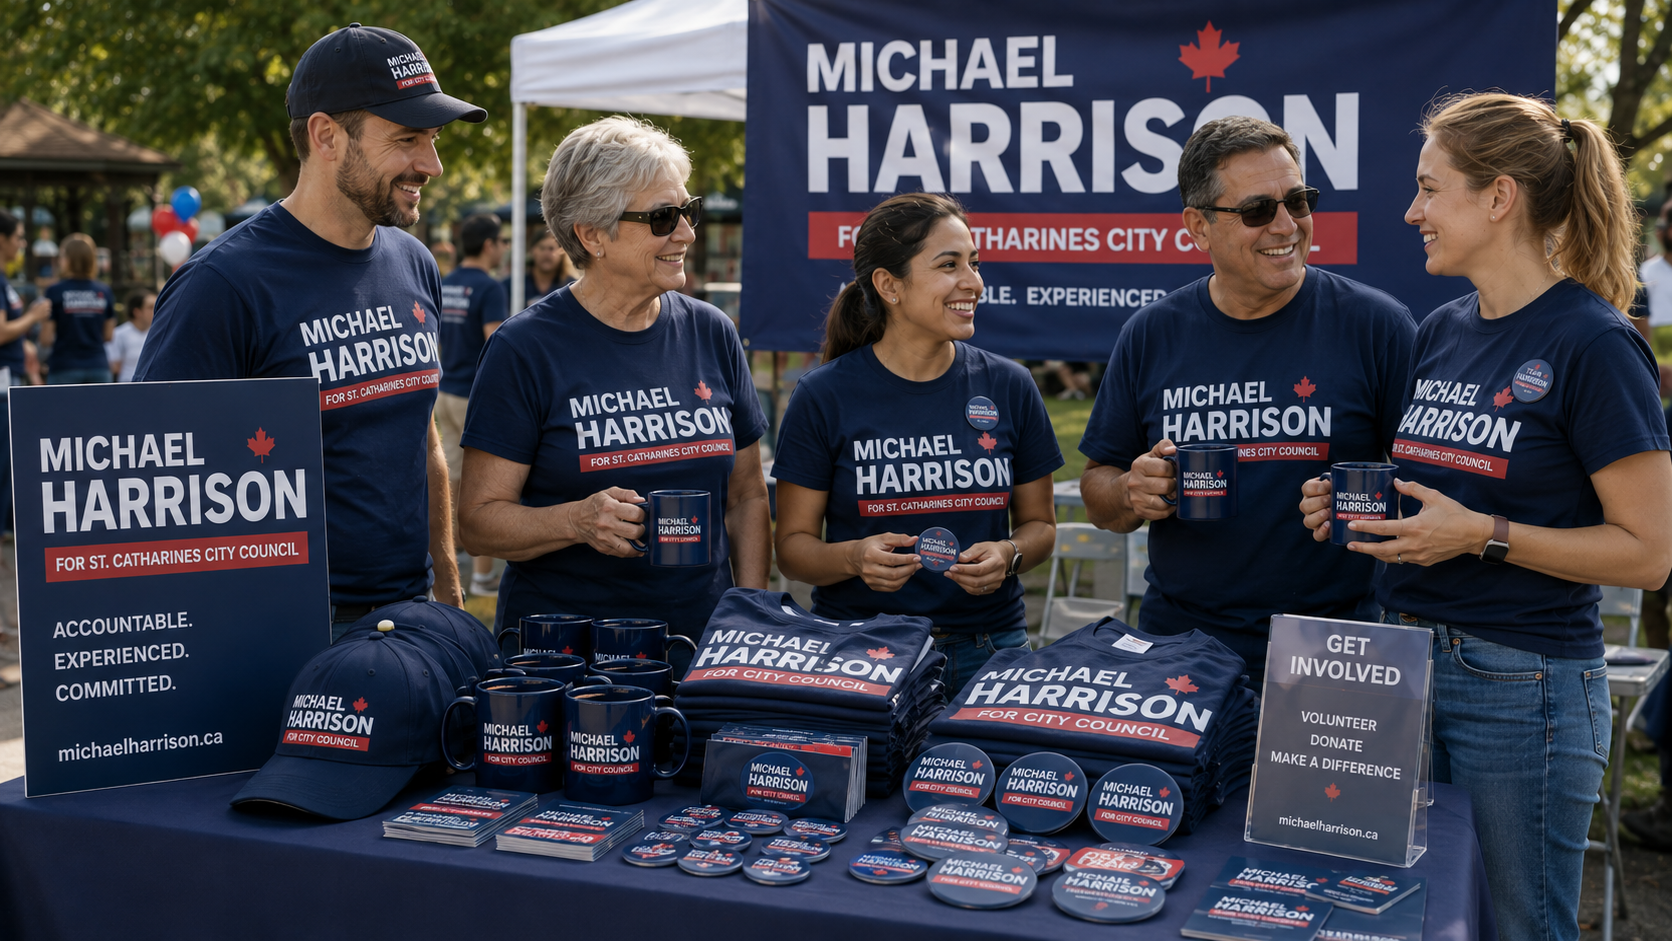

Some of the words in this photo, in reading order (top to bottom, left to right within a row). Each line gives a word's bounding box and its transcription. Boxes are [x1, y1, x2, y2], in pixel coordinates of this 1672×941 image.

[806, 35, 1074, 93] MICHAEL
[807, 92, 1360, 194] HARRISN
[970, 227, 1100, 252] THARINES
[1107, 228, 1168, 252] CITY
[299, 305, 402, 347] MICHAEL
[308, 332, 439, 384] HARRISON
[326, 392, 345, 405] FOR
[347, 389, 359, 400] ST.
[360, 379, 405, 398] CATHARINES
[405, 376, 422, 388] CITY
[1163, 381, 1272, 410] MICHAEL
[1413, 379, 1480, 406] MICHAEL
[569, 386, 680, 419] MICHAEL
[574, 406, 731, 450] HARRISON
[1163, 405, 1331, 442] HARRISON
[40, 432, 205, 473] MICHAEL
[590, 456, 610, 467] FOR
[612, 454, 626, 465] ST.
[627, 448, 680, 463] CATHARINES
[681, 445, 699, 456] CITY
[853, 434, 962, 461] MICHAEL
[1258, 447, 1277, 457] CITY
[1279, 446, 1319, 456] COUNCIL
[1441, 452, 1455, 463] CITY
[1455, 454, 1493, 472] COUNCIL
[855, 457, 1011, 495] HARRISON
[1183, 479, 1227, 489] HARRISON
[41, 469, 307, 534] HARRISON
[867, 503, 885, 513] FOR
[886, 502, 899, 512] ST.
[901, 499, 953, 511] CATHARINES
[954, 498, 973, 507] CITY
[1336, 501, 1386, 512] HARRISON
[658, 525, 701, 535] HARRISON
[56, 557, 85, 571] FOR
[89, 554, 110, 569] ST.
[112, 548, 201, 568] CATHARINES
[204, 545, 236, 561] CITY
[239, 542, 299, 560] COUNCIL
[53, 611, 193, 639] ACCOUNTABLE.
[708, 630, 832, 655] MICHAEL
[1326, 634, 1371, 656] GET
[54, 642, 190, 670] EXPERIENCED.
[695, 646, 903, 684] HARRISON
[703, 668, 738, 678] FOR
[743, 669, 785, 682] CITY
[788, 675, 868, 692] COUNCIL
[980, 665, 1132, 689] MICHAEL
[1290, 655, 1401, 686] INVOLVED
[55, 674, 177, 702] COMMITTED.
[293, 694, 346, 711] MICHAEL
[964, 682, 1213, 733] HARRISON
[286, 710, 374, 735] HARRISON
[484, 722, 533, 737] MICHAEL
[976, 710, 1019, 720] FOR
[1024, 712, 1071, 727] CITY
[1075, 718, 1170, 741] COUNCIL
[1301, 710, 1377, 731] VOLUNTEER
[58, 730, 223, 762] michaelharrison.ca
[298, 733, 316, 743] CITY
[316, 735, 359, 748] COUNCIL
[484, 735, 552, 753] HARRISON
[570, 731, 618, 746] MICHAEL
[1310, 733, 1363, 753] DONATE
[501, 756, 516, 764] CITY
[570, 745, 639, 762] HARRISON
[920, 756, 966, 769] MICHAEL
[587, 765, 601, 773] CITY
[750, 762, 792, 776] MICHAEL
[914, 766, 985, 785] HARRISON
[1010, 767, 1059, 781] MICHAEL
[1270, 750, 1307, 767] MAKE
[1309, 756, 1319, 768] A
[1321, 757, 1401, 780] DIFFERENCE
[748, 773, 808, 792] HARRISON
[1006, 778, 1078, 798] HARRISON
[1102, 781, 1153, 797] MICHAEL
[1022, 797, 1037, 805] CITY
[1098, 792, 1174, 816] HARRISON
[1101, 811, 1115, 820] FOR
[1115, 814, 1132, 823] CITY
[1278, 815, 1378, 841] michaelharrison.ca
[911, 829, 1002, 850] HARRISON
[938, 865, 1028, 886] HARRISON
[945, 858, 1004, 872] MICHAEL
[1243, 867, 1308, 882] MICHAEL
[1064, 875, 1157, 897] HARRISON
[1236, 872, 1319, 889] HARRIS
[1214, 900, 1315, 921] HARRISON
[1221, 896, 1287, 911] MICHAEL
